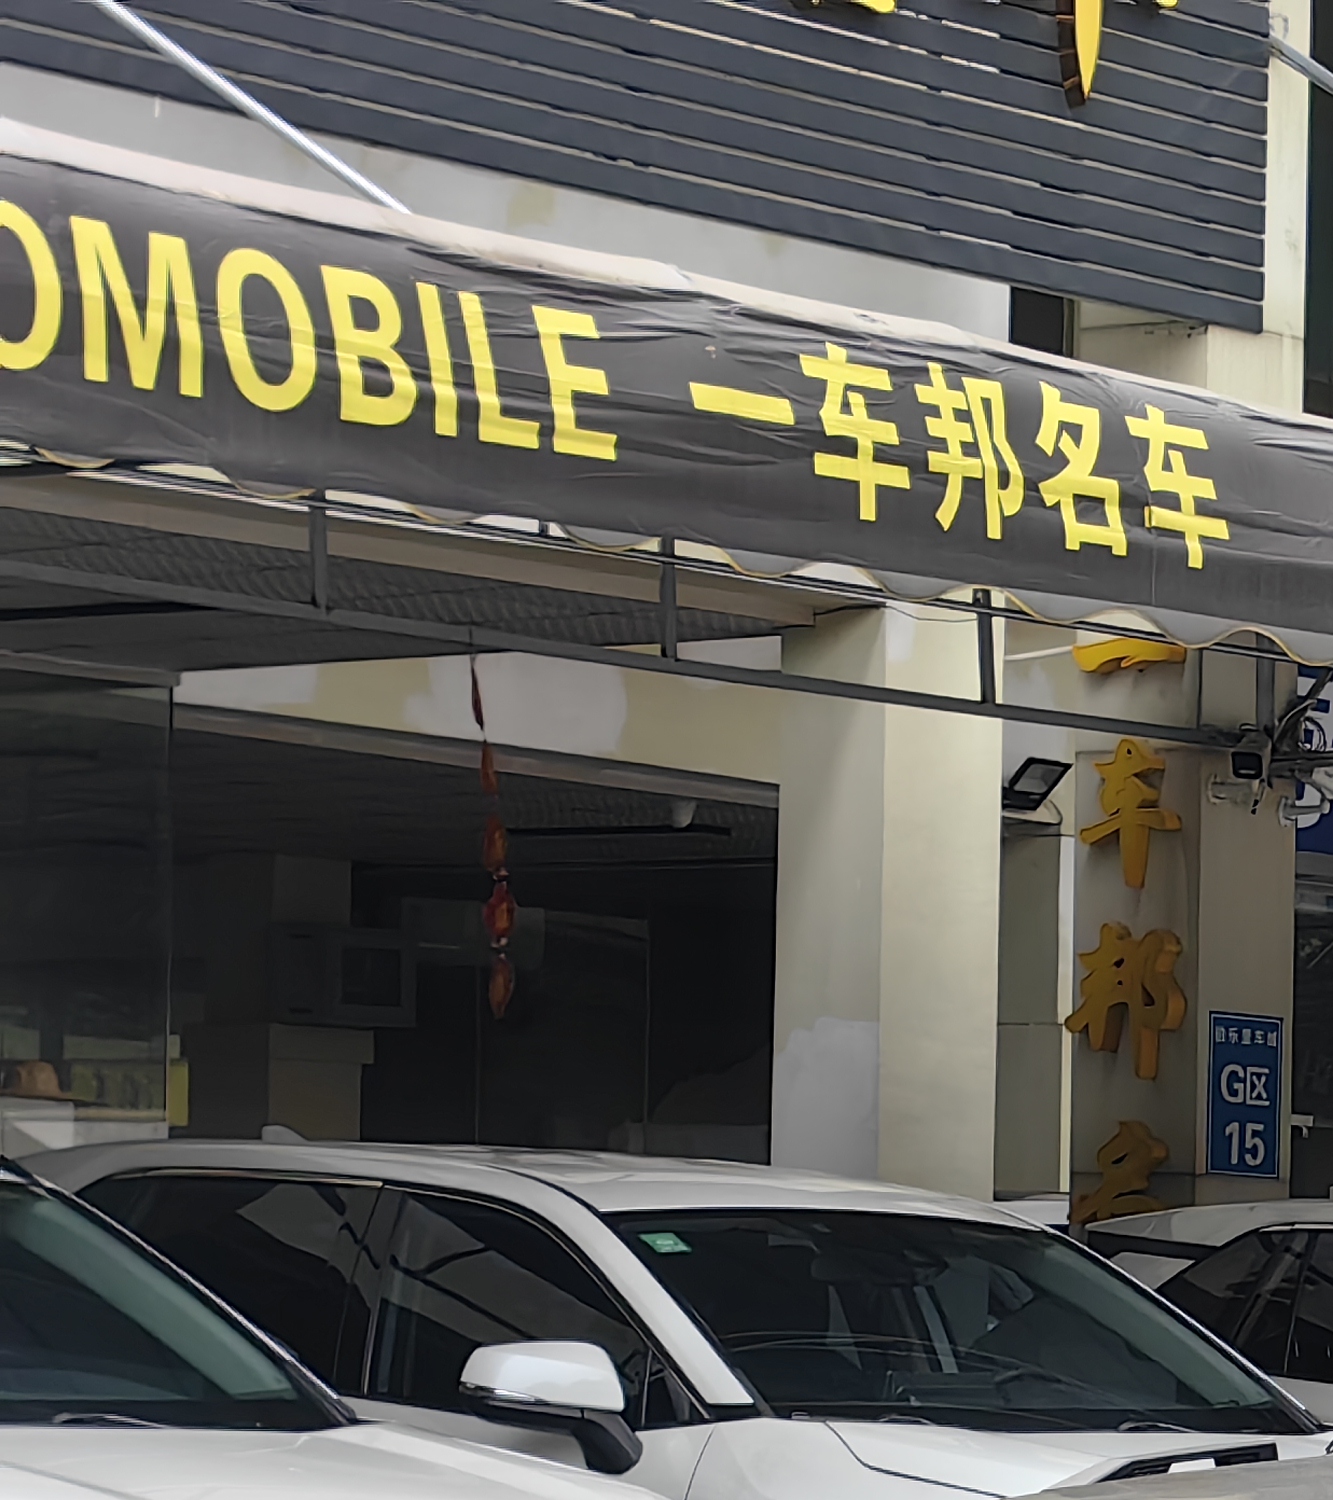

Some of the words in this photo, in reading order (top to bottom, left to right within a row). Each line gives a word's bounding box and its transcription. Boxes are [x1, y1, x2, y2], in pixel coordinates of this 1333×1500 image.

[0, 207, 618, 463] OMOBILE
[688, 340, 1232, 571] 一车邦名车
[1220, 1063, 1270, 1107] G区
[1224, 1121, 1265, 1167] 15
